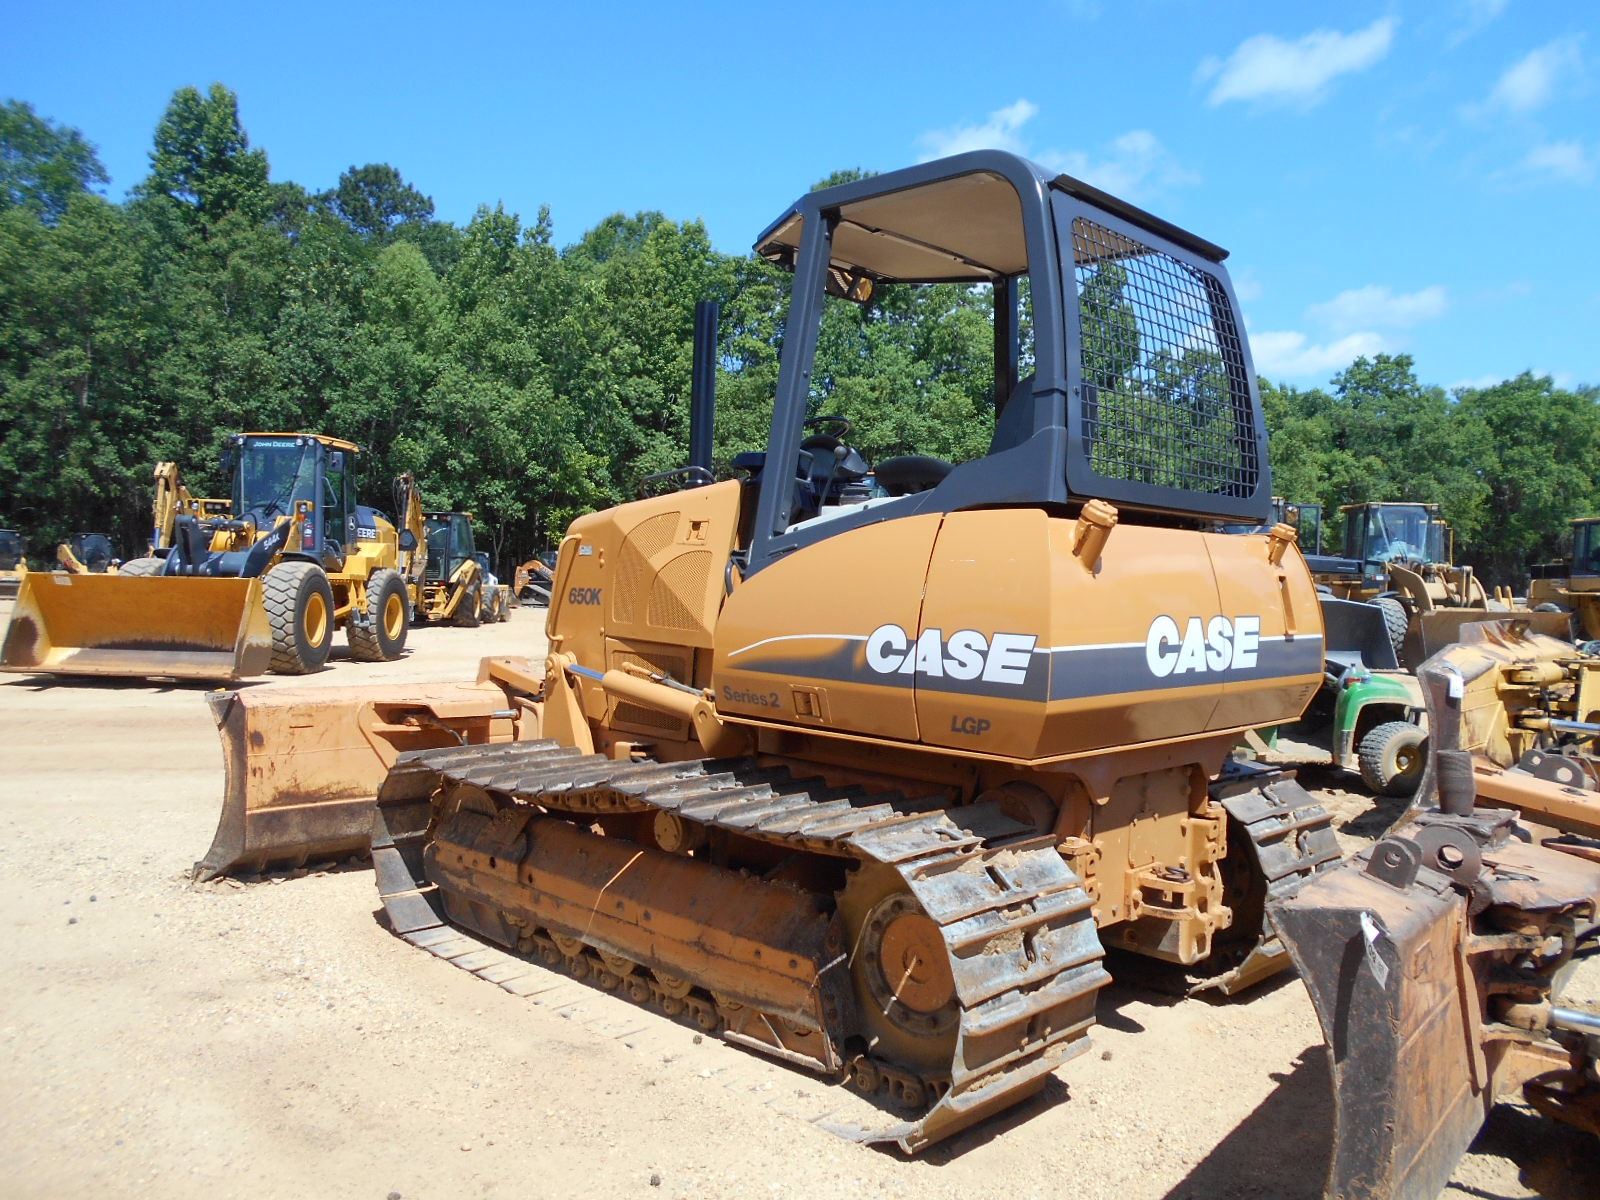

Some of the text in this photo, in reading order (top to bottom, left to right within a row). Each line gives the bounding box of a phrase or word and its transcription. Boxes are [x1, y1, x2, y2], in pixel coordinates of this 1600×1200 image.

[357, 527, 376, 539] EERE
[569, 587, 602, 606] 650K
[865, 623, 1038, 685] CASE
[1146, 614, 1260, 678] CASE
[723, 685, 781, 708] Series 2
[951, 715, 991, 736] LGP
